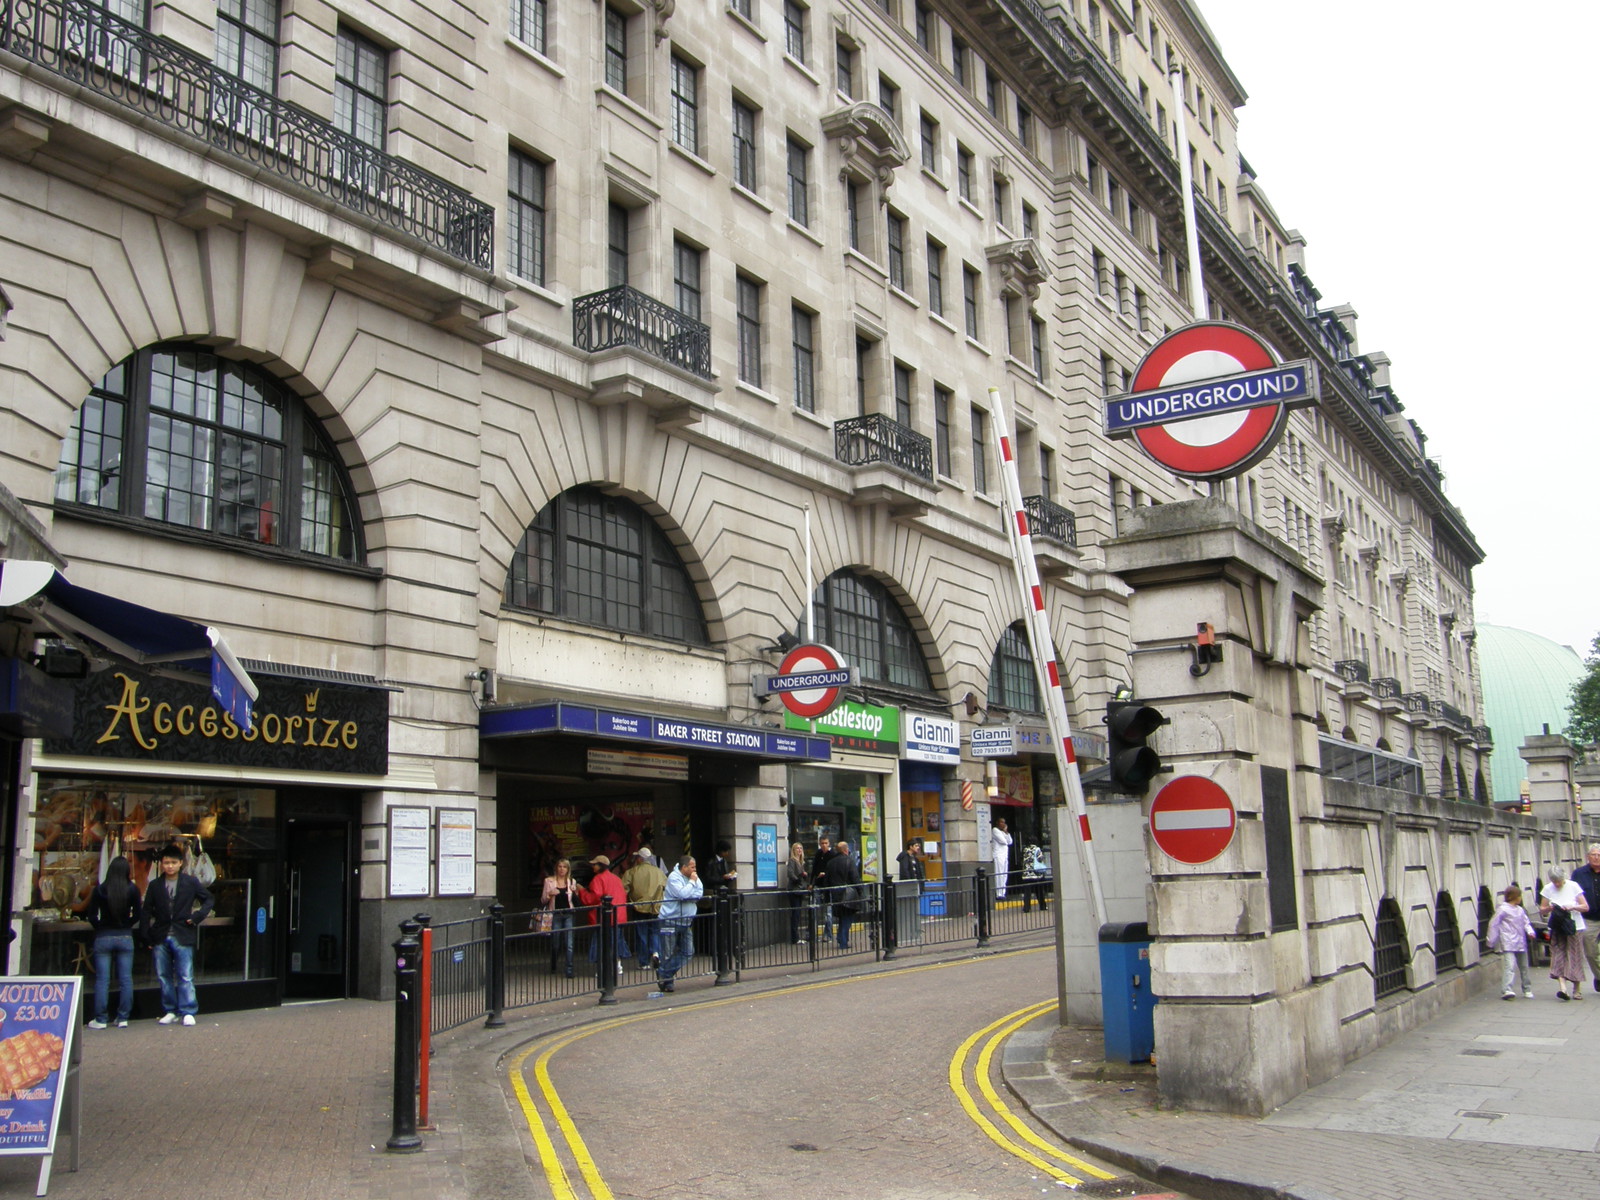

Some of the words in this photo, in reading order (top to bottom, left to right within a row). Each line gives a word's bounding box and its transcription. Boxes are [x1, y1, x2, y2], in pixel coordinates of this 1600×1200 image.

[1118, 373, 1300, 422] UNDERGROUND
[772, 672, 848, 689] UNDERGROUND
[657, 722, 688, 739] BAKER
[691, 727, 722, 743] STREET
[726, 732, 760, 748] STATION
[913, 717, 954, 744] Gianni
[973, 727, 1011, 740] Gianni
[1016, 731, 1040, 745] HE
[530, 807, 549, 817] THE
[554, 805, 568, 816] No
[757, 829, 771, 842] Stay
[14, 1004, 61, 1021] £3.00
[14, 1087, 52, 1100] Waffle
[9, 1119, 48, 1133] Drink
